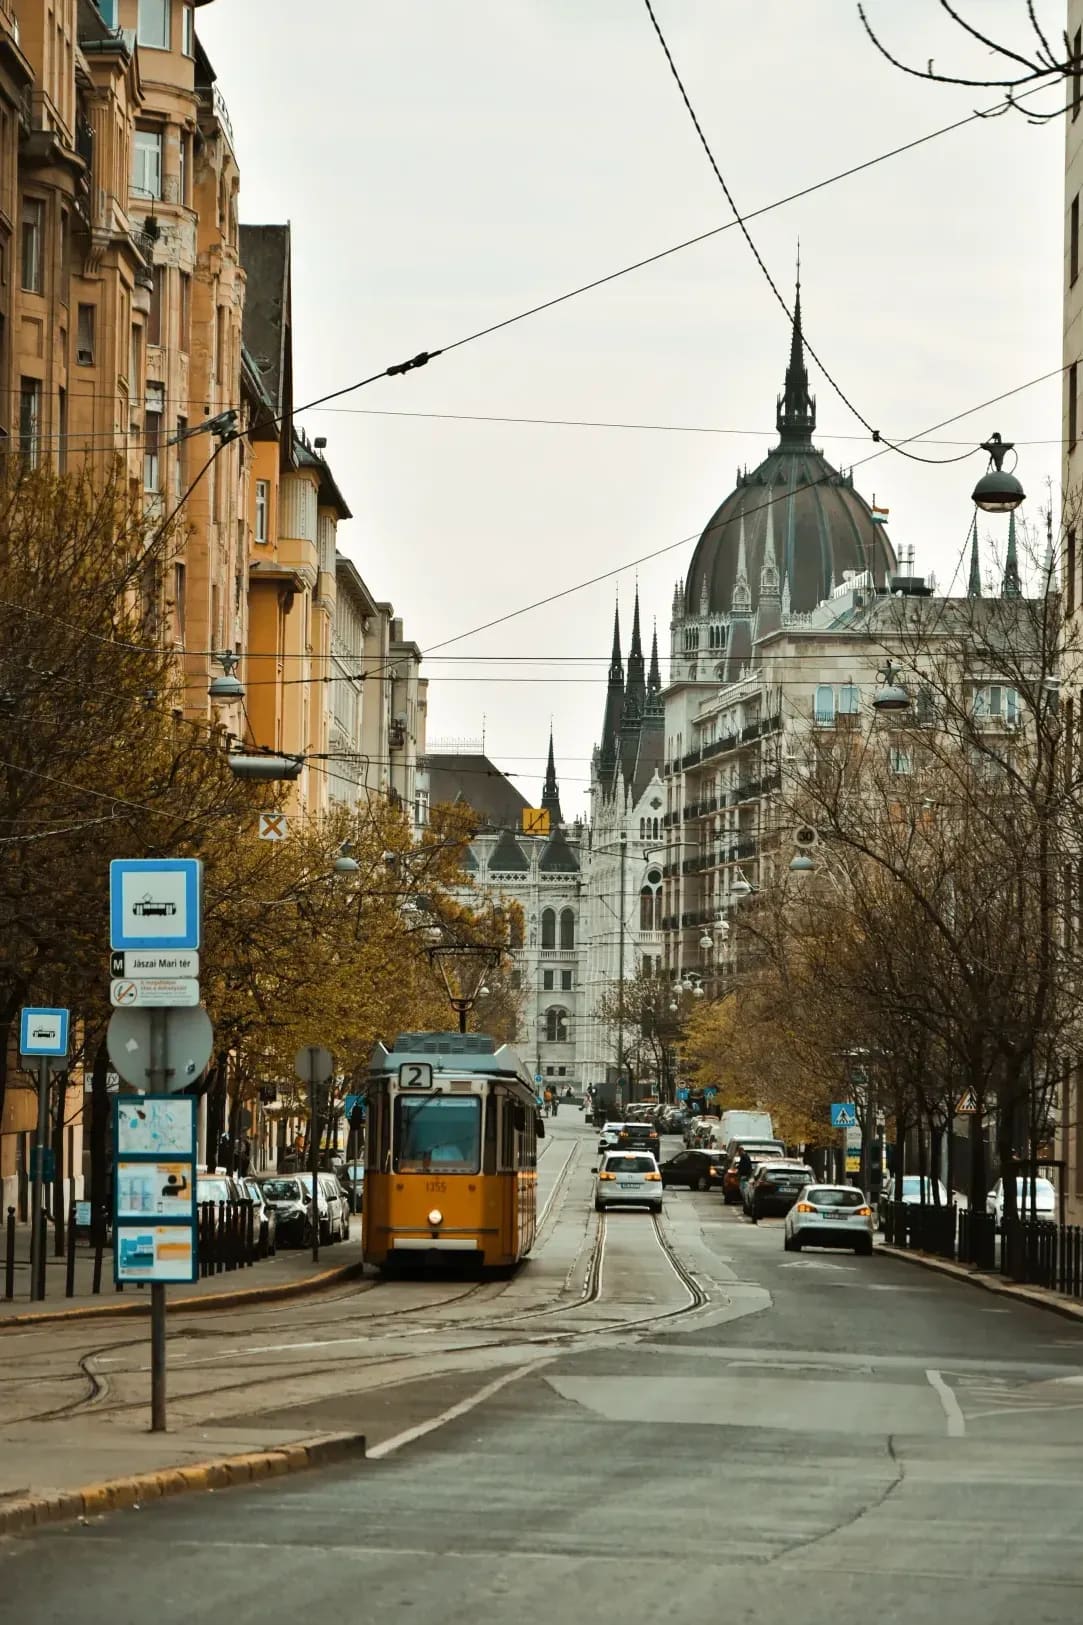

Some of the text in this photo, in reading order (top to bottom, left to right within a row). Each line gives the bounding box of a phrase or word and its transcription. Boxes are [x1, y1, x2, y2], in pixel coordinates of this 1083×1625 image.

[799, 831, 813, 841] 30
[113, 959, 123, 971] M
[133, 958, 191, 969] Jászai Mari tér
[408, 1066, 422, 1087] 2
